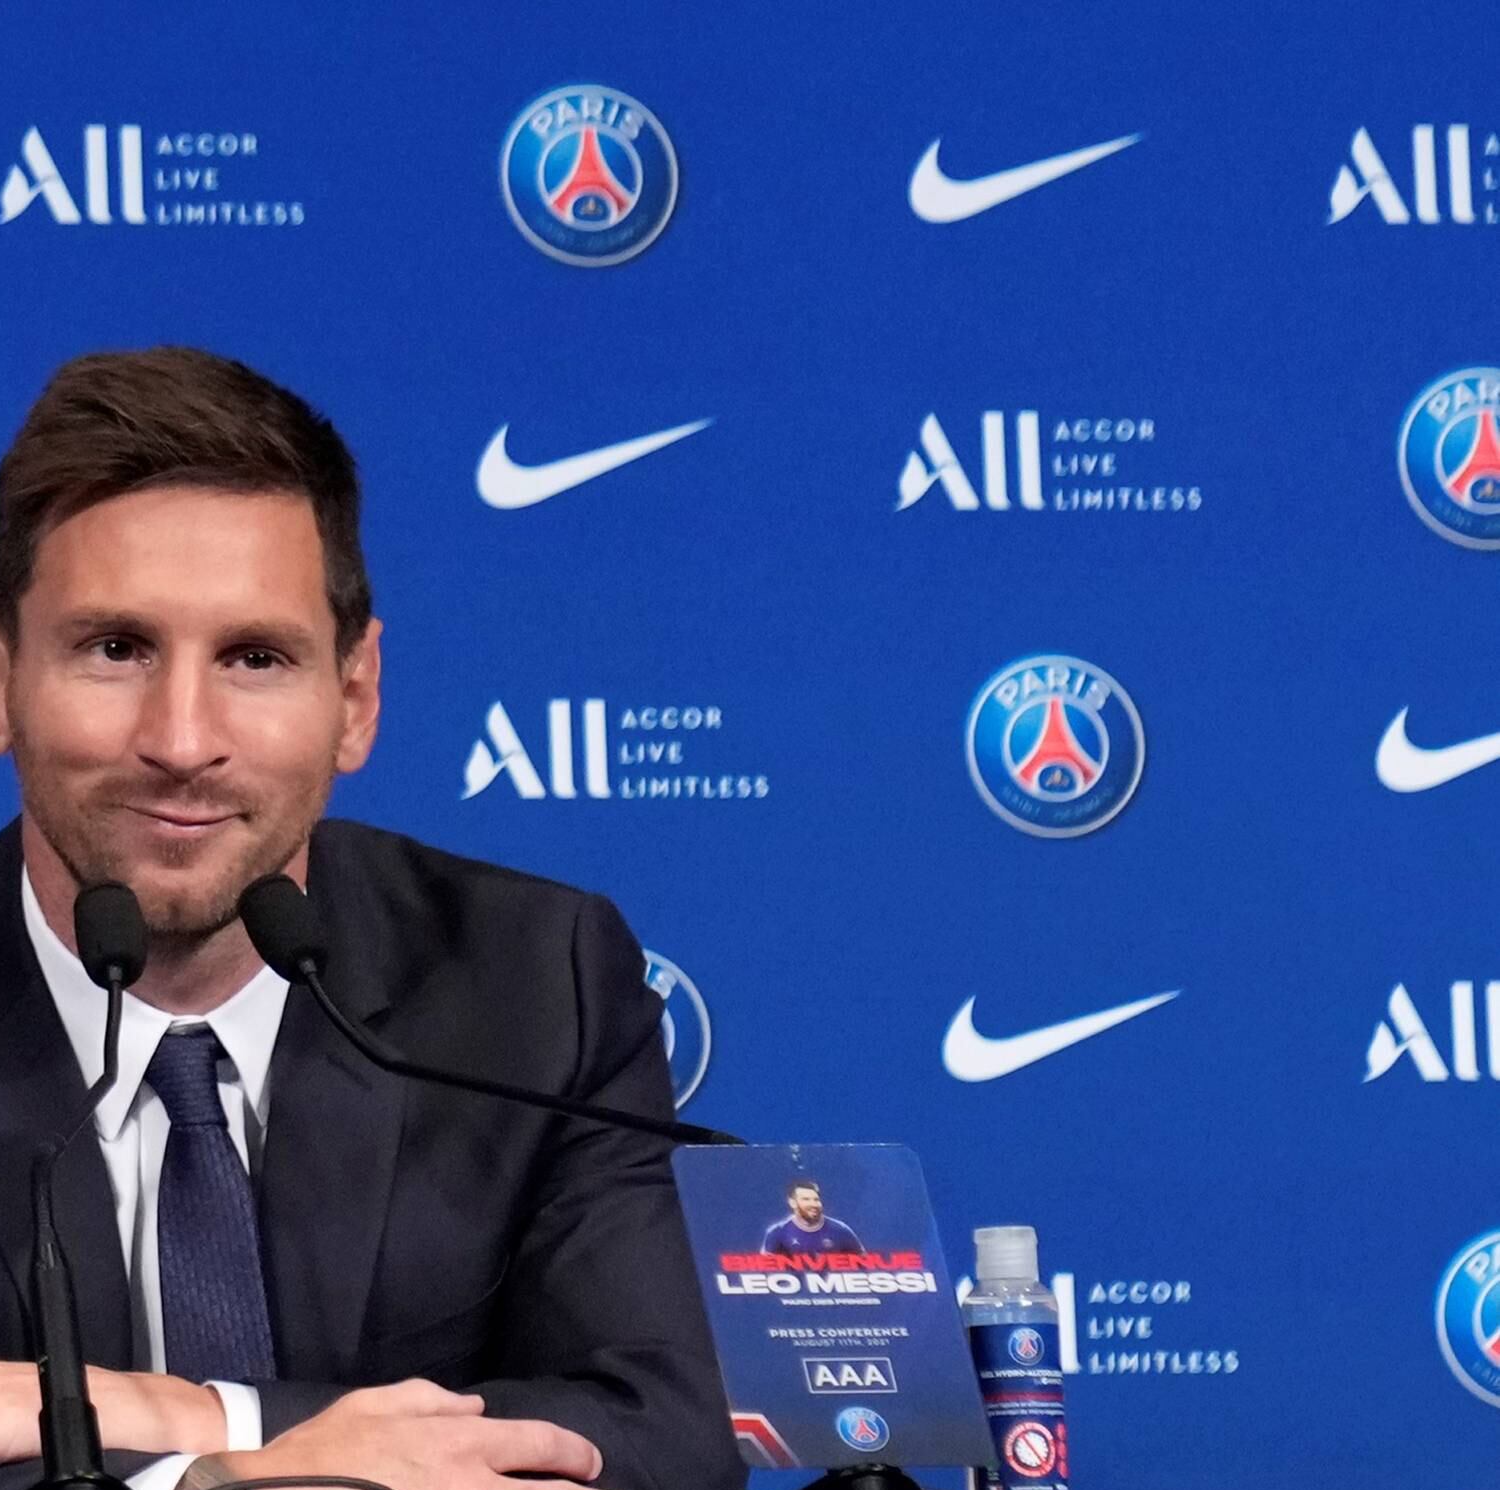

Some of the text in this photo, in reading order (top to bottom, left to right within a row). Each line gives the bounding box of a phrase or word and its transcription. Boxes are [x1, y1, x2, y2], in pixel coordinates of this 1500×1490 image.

[530, 97, 645, 141] PARIS
[157, 133, 258, 156] ACCOR
[156, 167, 217, 190] LIVE
[157, 202, 305, 226] LIMITLESS
[1054, 418, 1155, 442] ACCOR
[1052, 453, 1115, 476] LIVE
[1054, 487, 1203, 511] LIMITLESS
[996, 667, 1111, 712] PARIS
[621, 706, 722, 730] ACCOR
[619, 741, 683, 765] LIVE
[621, 775, 770, 799] LIMITLESS
[719, 1252, 923, 1271] BIENVENUE
[716, 1272, 937, 1294] LEO MESSI
[1088, 1280, 1191, 1305] ACCOR
[769, 1327, 910, 1338] PRESS CONFERENCE
[1087, 1316, 1153, 1340] LIVE
[1088, 1350, 1240, 1375] LIMITLESS
[815, 1364, 888, 1387] AAA
